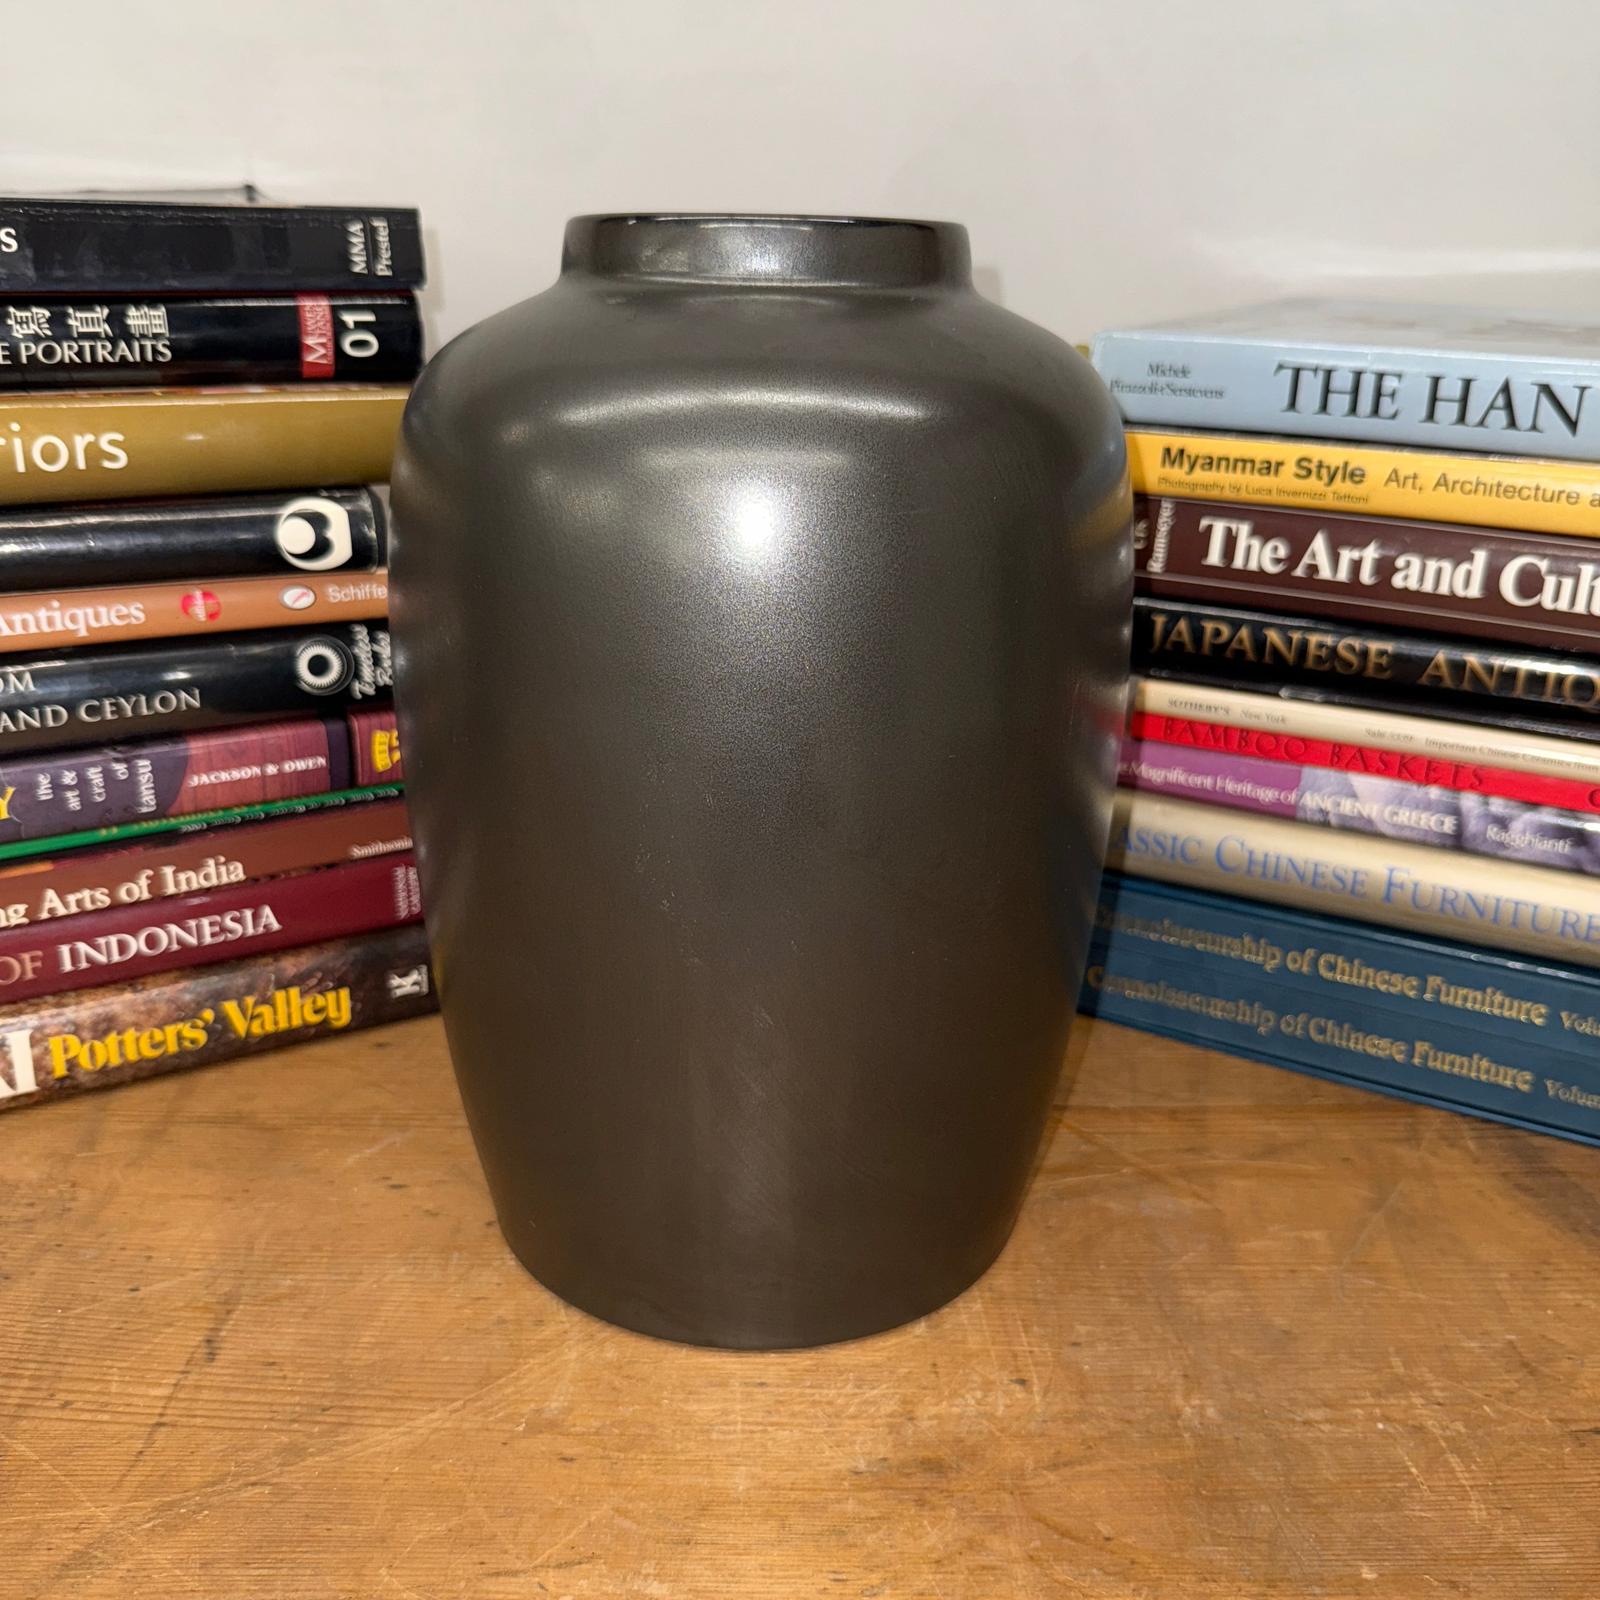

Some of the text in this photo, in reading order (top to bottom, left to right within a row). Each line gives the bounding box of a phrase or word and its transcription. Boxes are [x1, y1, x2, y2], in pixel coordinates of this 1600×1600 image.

[347, 219, 368, 275] MMA
[369, 216, 393, 277] Prestel
[19, 338, 173, 365] PORTRAITS
[338, 310, 379, 358] 01
[1273, 361, 1593, 438] THE HAN
[0, 421, 129, 473] iors
[1160, 446, 1285, 479] Myanmar
[1292, 456, 1367, 488] Style
[1383, 467, 1424, 495] Art,
[1431, 471, 1581, 507] Architecture
[1198, 515, 1292, 575] The
[1290, 527, 1384, 586] Art
[1390, 549, 1488, 600] and
[1149, 612, 1397, 681] JAPANESE
[76, 687, 201, 723] CEYLON
[187, 755, 328, 788] JACKSON & OWEN
[1162, 714, 1307, 762] BAMBOO
[1328, 742, 1485, 789] BASKETS
[1215, 774, 1280, 805] Heritage
[1279, 789, 1298, 804] of
[1299, 790, 1381, 819] ANCIENT
[1383, 806, 1459, 836] GREECE
[37, 887, 112, 921] Arts
[116, 868, 155, 904] of
[159, 854, 248, 896] India
[1214, 832, 1371, 899] CHINESE
[0, 903, 284, 986] OF INDONESIA
[1285, 947, 1321, 975] of
[1317, 952, 1423, 999] Chinese
[1423, 973, 1550, 1028] Furniture
[47, 1007, 216, 1081] Potters'
[219, 985, 352, 1041] Valley
[1279, 1011, 1309, 1039] of
[1307, 1016, 1410, 1064] Chinese
[1411, 1038, 1537, 1094] Furniture
